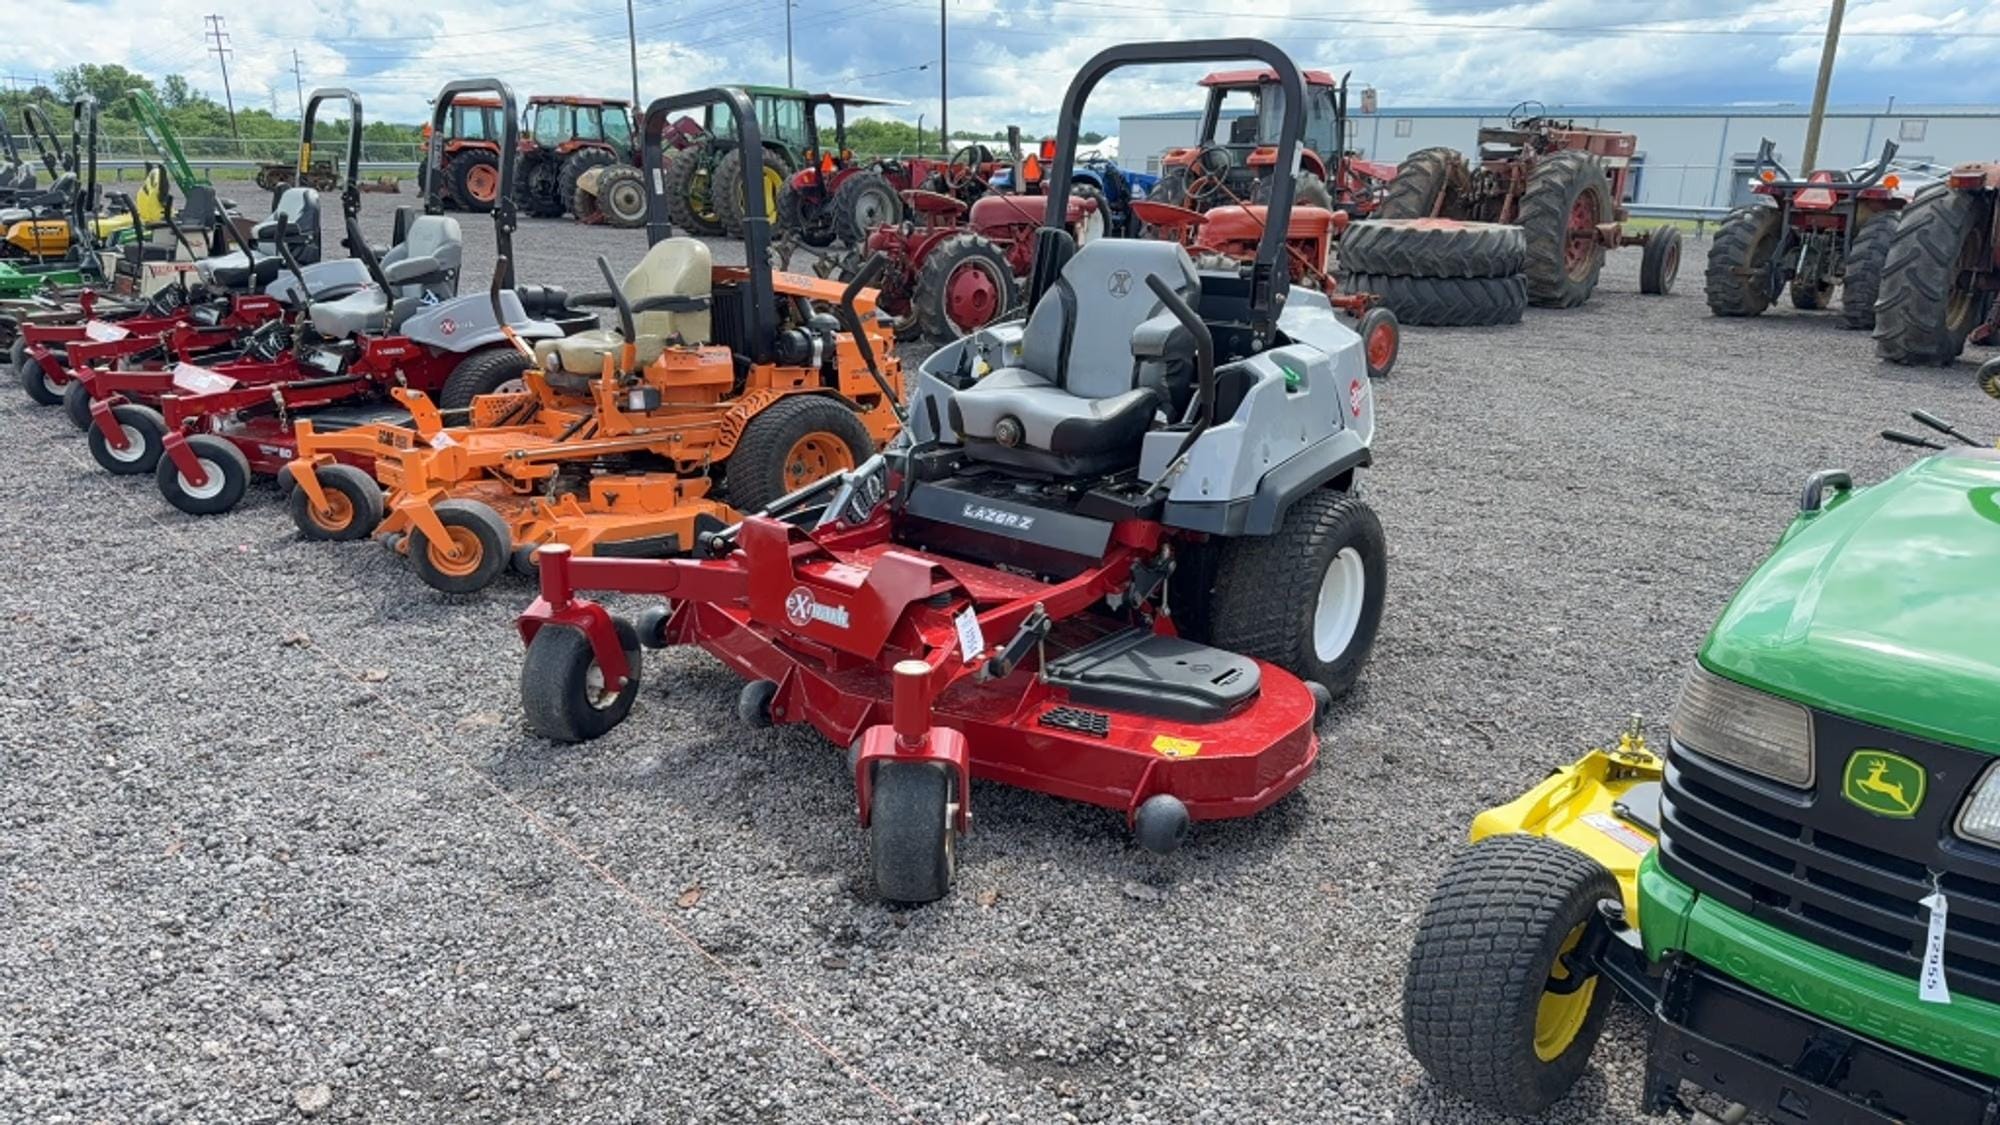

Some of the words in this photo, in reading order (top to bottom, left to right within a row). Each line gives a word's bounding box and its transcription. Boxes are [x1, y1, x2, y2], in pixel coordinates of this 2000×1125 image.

[962, 503, 1019, 528] LAZER
[1019, 515, 1035, 531] Z
[1927, 935, 1941, 989] 12955
[1703, 939, 1810, 1006] JOHN
[1824, 997, 1987, 1069] DEERE
